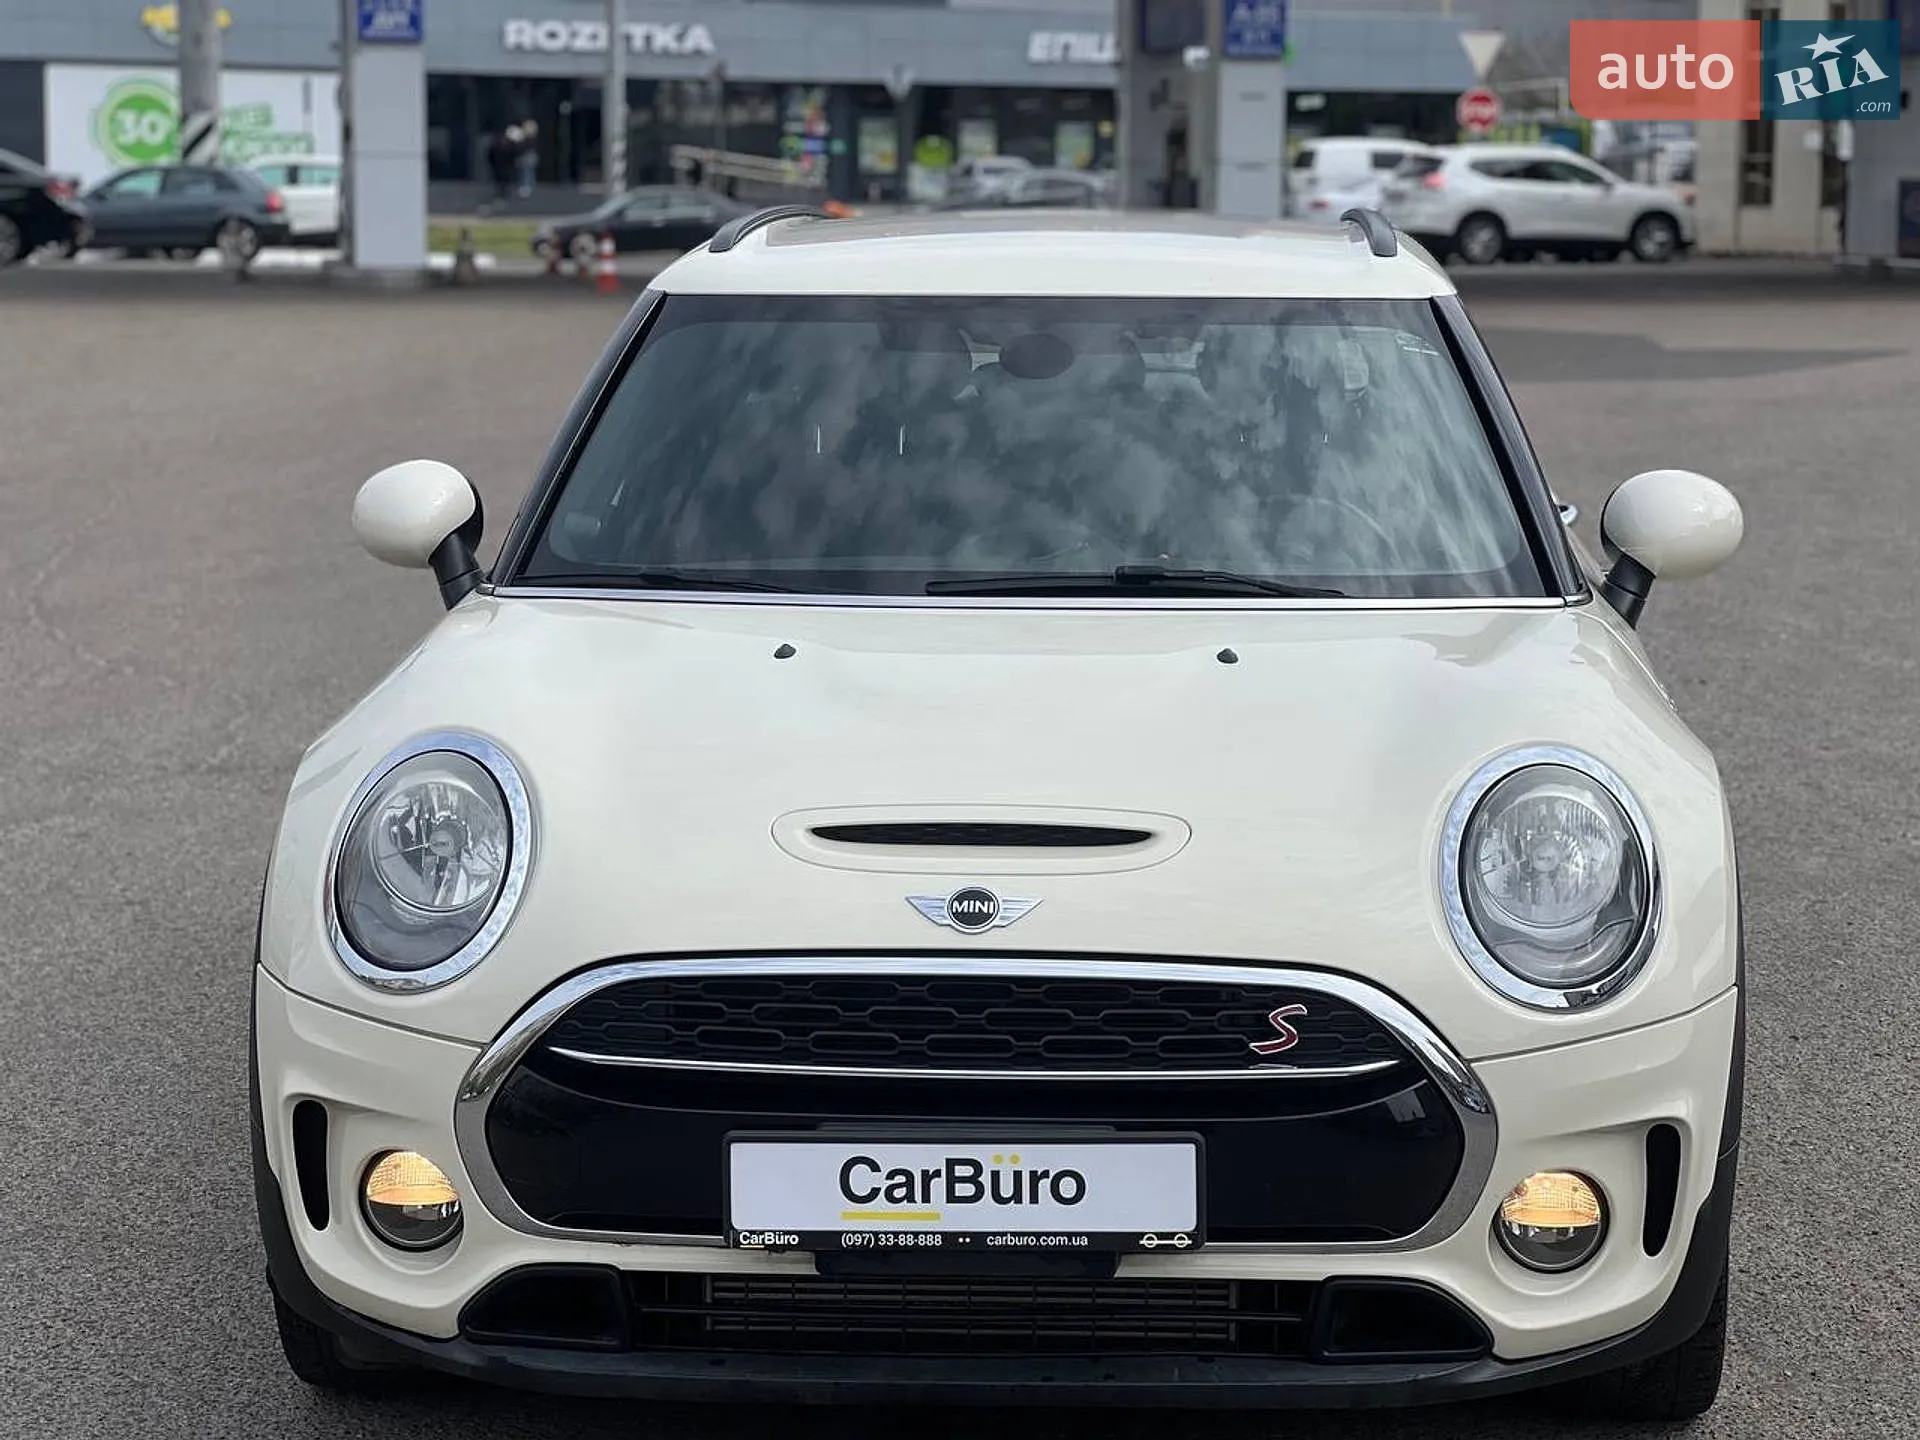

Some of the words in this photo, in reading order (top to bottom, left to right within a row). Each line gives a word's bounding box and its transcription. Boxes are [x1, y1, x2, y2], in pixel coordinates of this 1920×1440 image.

[952, 899, 995, 914] MINI
[1249, 1004, 1308, 1055] S
[839, 1153, 1087, 1206] CarBüro
[738, 1231, 800, 1246] CarBüro
[840, 1233, 875, 1248] (097)
[877, 1233, 943, 1247] 33-88-888
[985, 1232, 1089, 1247] carburo.com.ua
